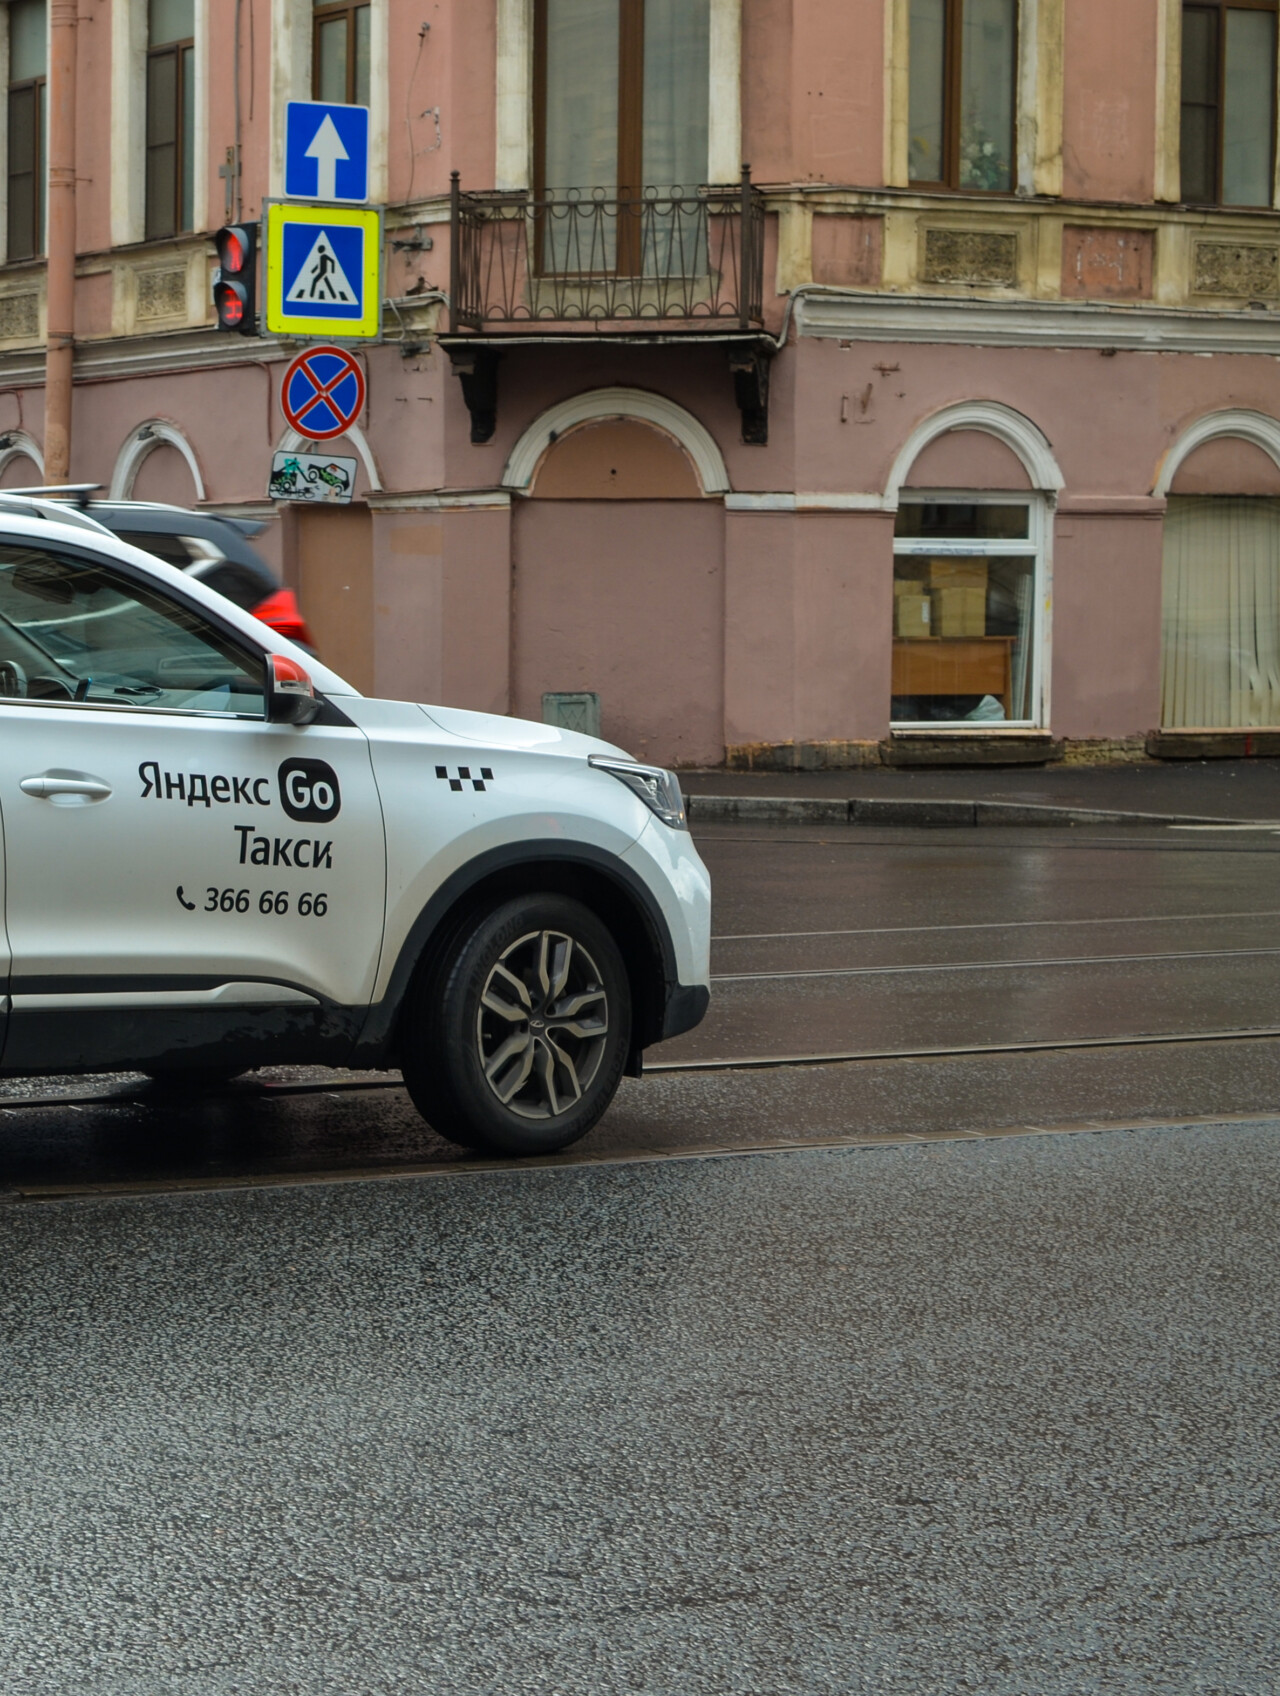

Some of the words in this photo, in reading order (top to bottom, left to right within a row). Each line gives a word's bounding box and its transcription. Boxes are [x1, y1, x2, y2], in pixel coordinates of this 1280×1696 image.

[138, 760, 271, 808] Яндекс
[285, 769, 335, 811] Go
[233, 825, 334, 870] Такси
[204, 887, 251, 914] 366
[258, 889, 290, 915] 66
[297, 892, 328, 918] 66
